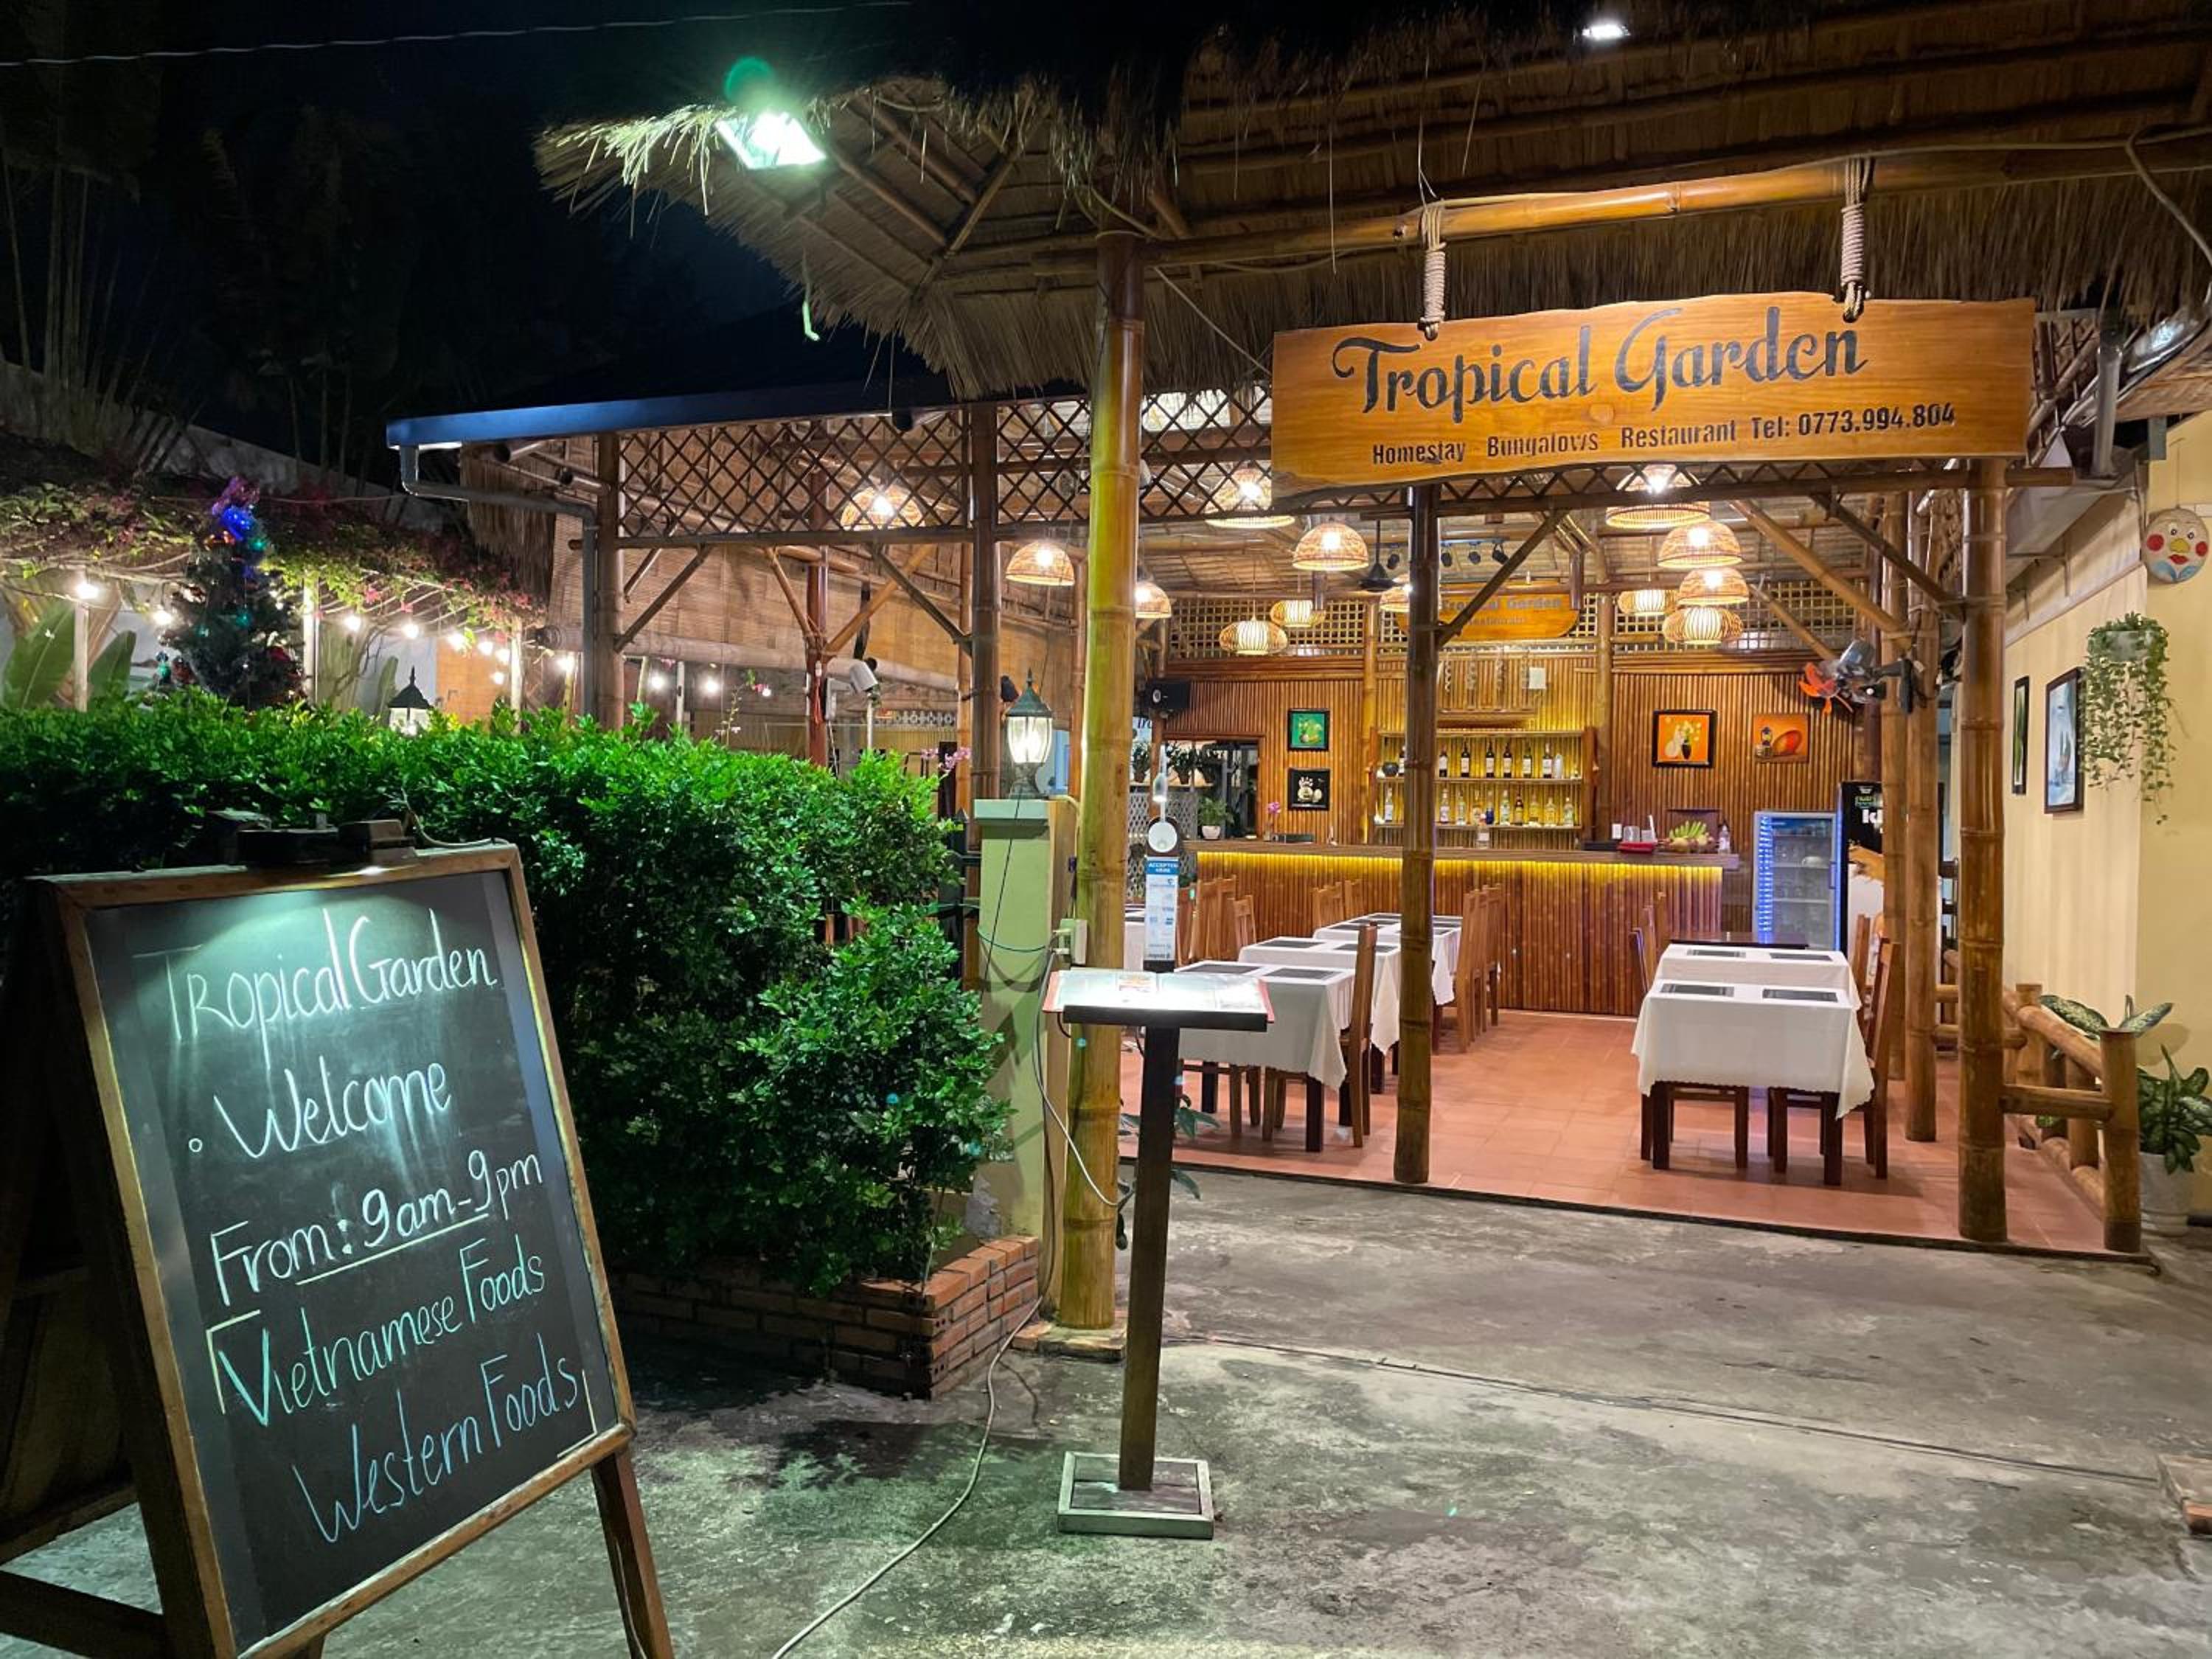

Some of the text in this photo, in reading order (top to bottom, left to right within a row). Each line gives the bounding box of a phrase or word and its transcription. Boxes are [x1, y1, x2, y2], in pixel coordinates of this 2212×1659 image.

[1332, 306, 1868, 422] Tropical Garden
[1372, 442, 1465, 465] Homestay
[1621, 420, 1736, 448] Restaurant
[1751, 416, 1790, 439] Tel:
[1798, 403, 1955, 437] 0773.994.804
